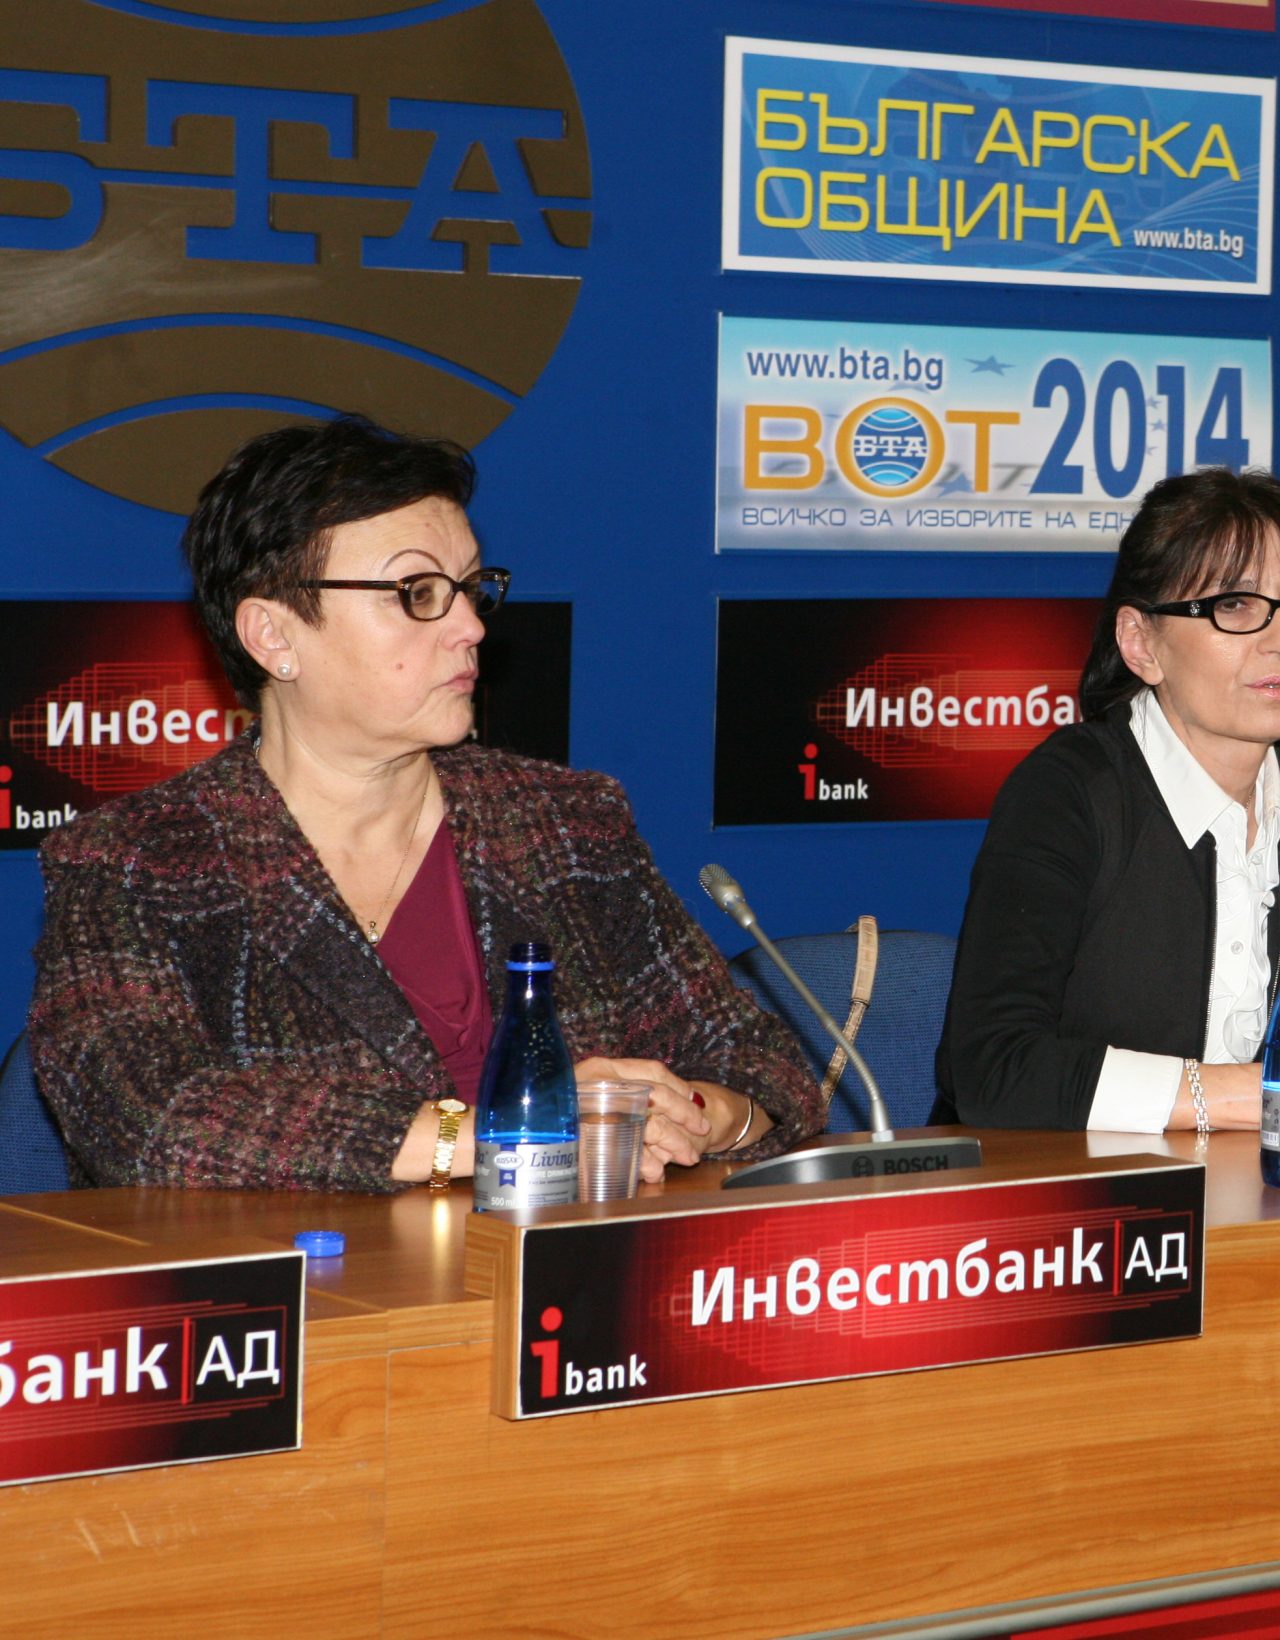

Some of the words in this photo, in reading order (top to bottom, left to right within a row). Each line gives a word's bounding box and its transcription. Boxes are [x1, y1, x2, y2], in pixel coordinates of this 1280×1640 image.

[755, 88, 1241, 182] БЪЛГАРСКА
[754, 167, 1122, 251] ОБЩИНА
[1133, 227, 1245, 258] www.bta.bg
[747, 347, 944, 391] www.bta.bg
[743, 396, 1021, 499] ВОТ
[1029, 358, 1250, 498] 2014
[853, 435, 928, 458] БТА
[742, 507, 846, 526] ВСИЧКО
[860, 508, 893, 527] ЗА
[906, 509, 1032, 528] ИЗБОРИТЕ
[1045, 511, 1076, 528] НА
[845, 685, 1084, 728] Инвестба
[530, 1151, 574, 1168] Living
[883, 1154, 949, 1174] BOSCH
[691, 1227, 1105, 1326] Инвестбанк
[1124, 1231, 1188, 1283] АД
[196, 1330, 280, 1389] АД
